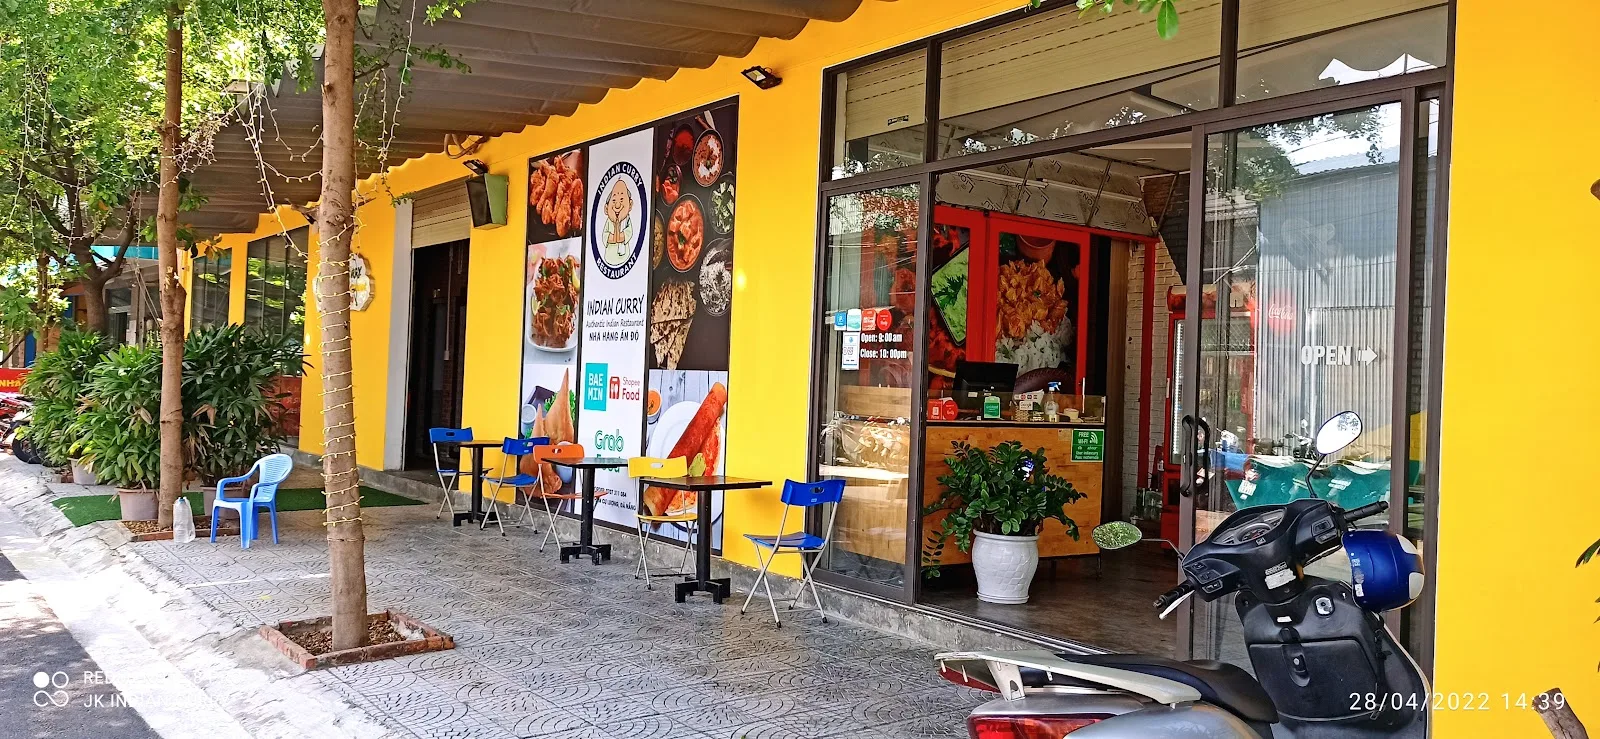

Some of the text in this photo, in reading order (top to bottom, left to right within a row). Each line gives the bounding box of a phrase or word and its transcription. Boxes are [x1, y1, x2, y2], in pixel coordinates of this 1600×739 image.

[597, 163, 643, 196] INDIAN CURRY
[596, 253, 638, 279] RESTAURANT
[586, 294, 645, 316] INDIAN CURRY
[606, 318, 619, 328] Indian
[620, 318, 644, 328] Restaurant
[861, 333, 878, 343] Open:
[860, 349, 879, 359] Close:
[1301, 345, 1351, 365] OPEN
[588, 373, 604, 387] BAE
[622, 377, 641, 389] Shopee
[587, 387, 604, 401] MIN
[621, 388, 640, 401] Food
[595, 429, 624, 452] Grab
